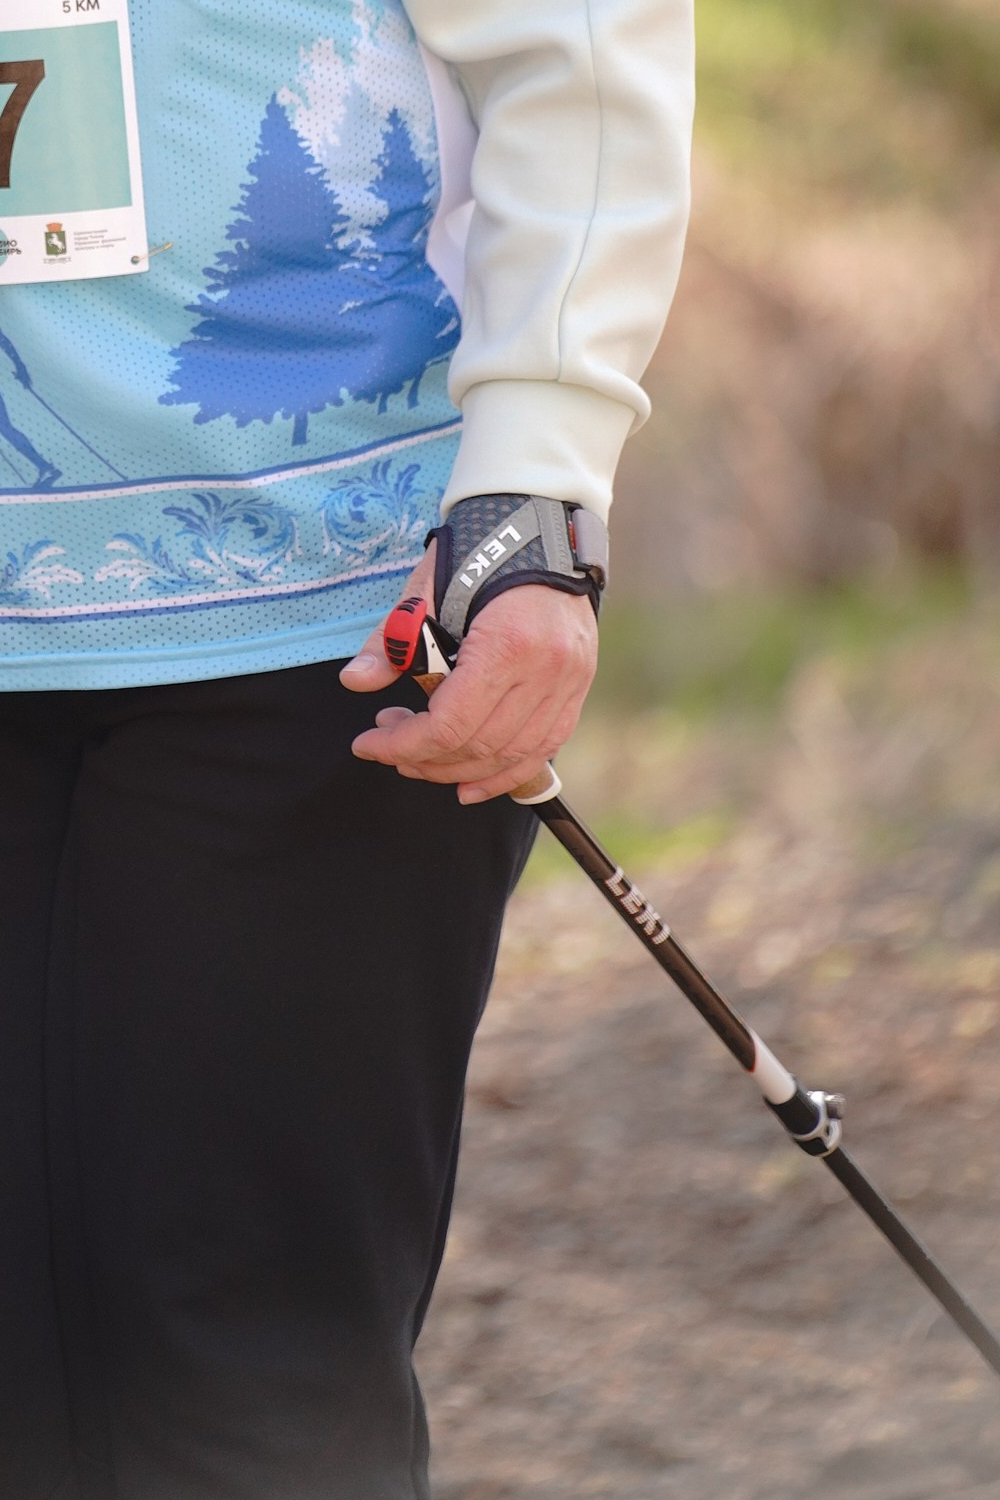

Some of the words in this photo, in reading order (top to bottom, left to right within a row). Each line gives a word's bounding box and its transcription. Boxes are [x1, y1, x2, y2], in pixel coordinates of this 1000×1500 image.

[62, 0, 71, 14] 5
[459, 524, 522, 589] LEKI
[604, 865, 670, 945] LEKI
